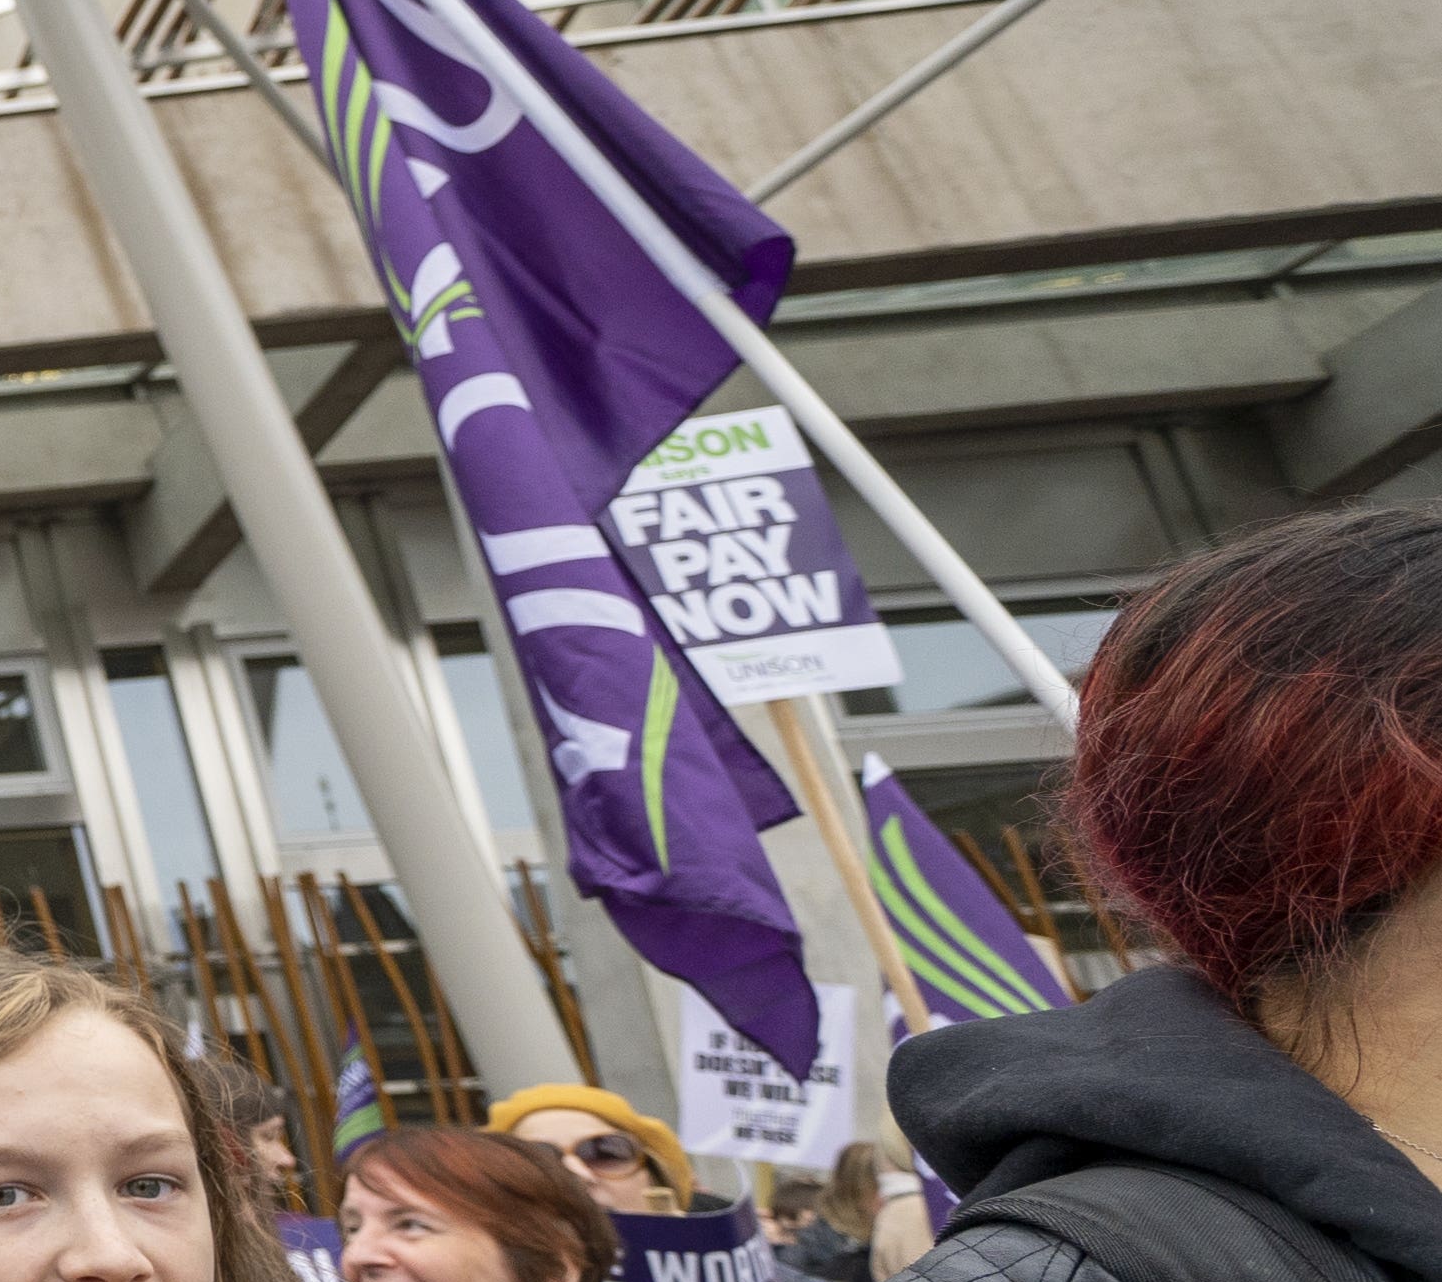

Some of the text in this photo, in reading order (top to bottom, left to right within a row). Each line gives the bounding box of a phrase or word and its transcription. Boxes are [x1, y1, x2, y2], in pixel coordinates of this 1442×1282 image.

[608, 476, 798, 547] FAIR
[649, 524, 793, 593] PAY
[651, 570, 842, 644] NOW
